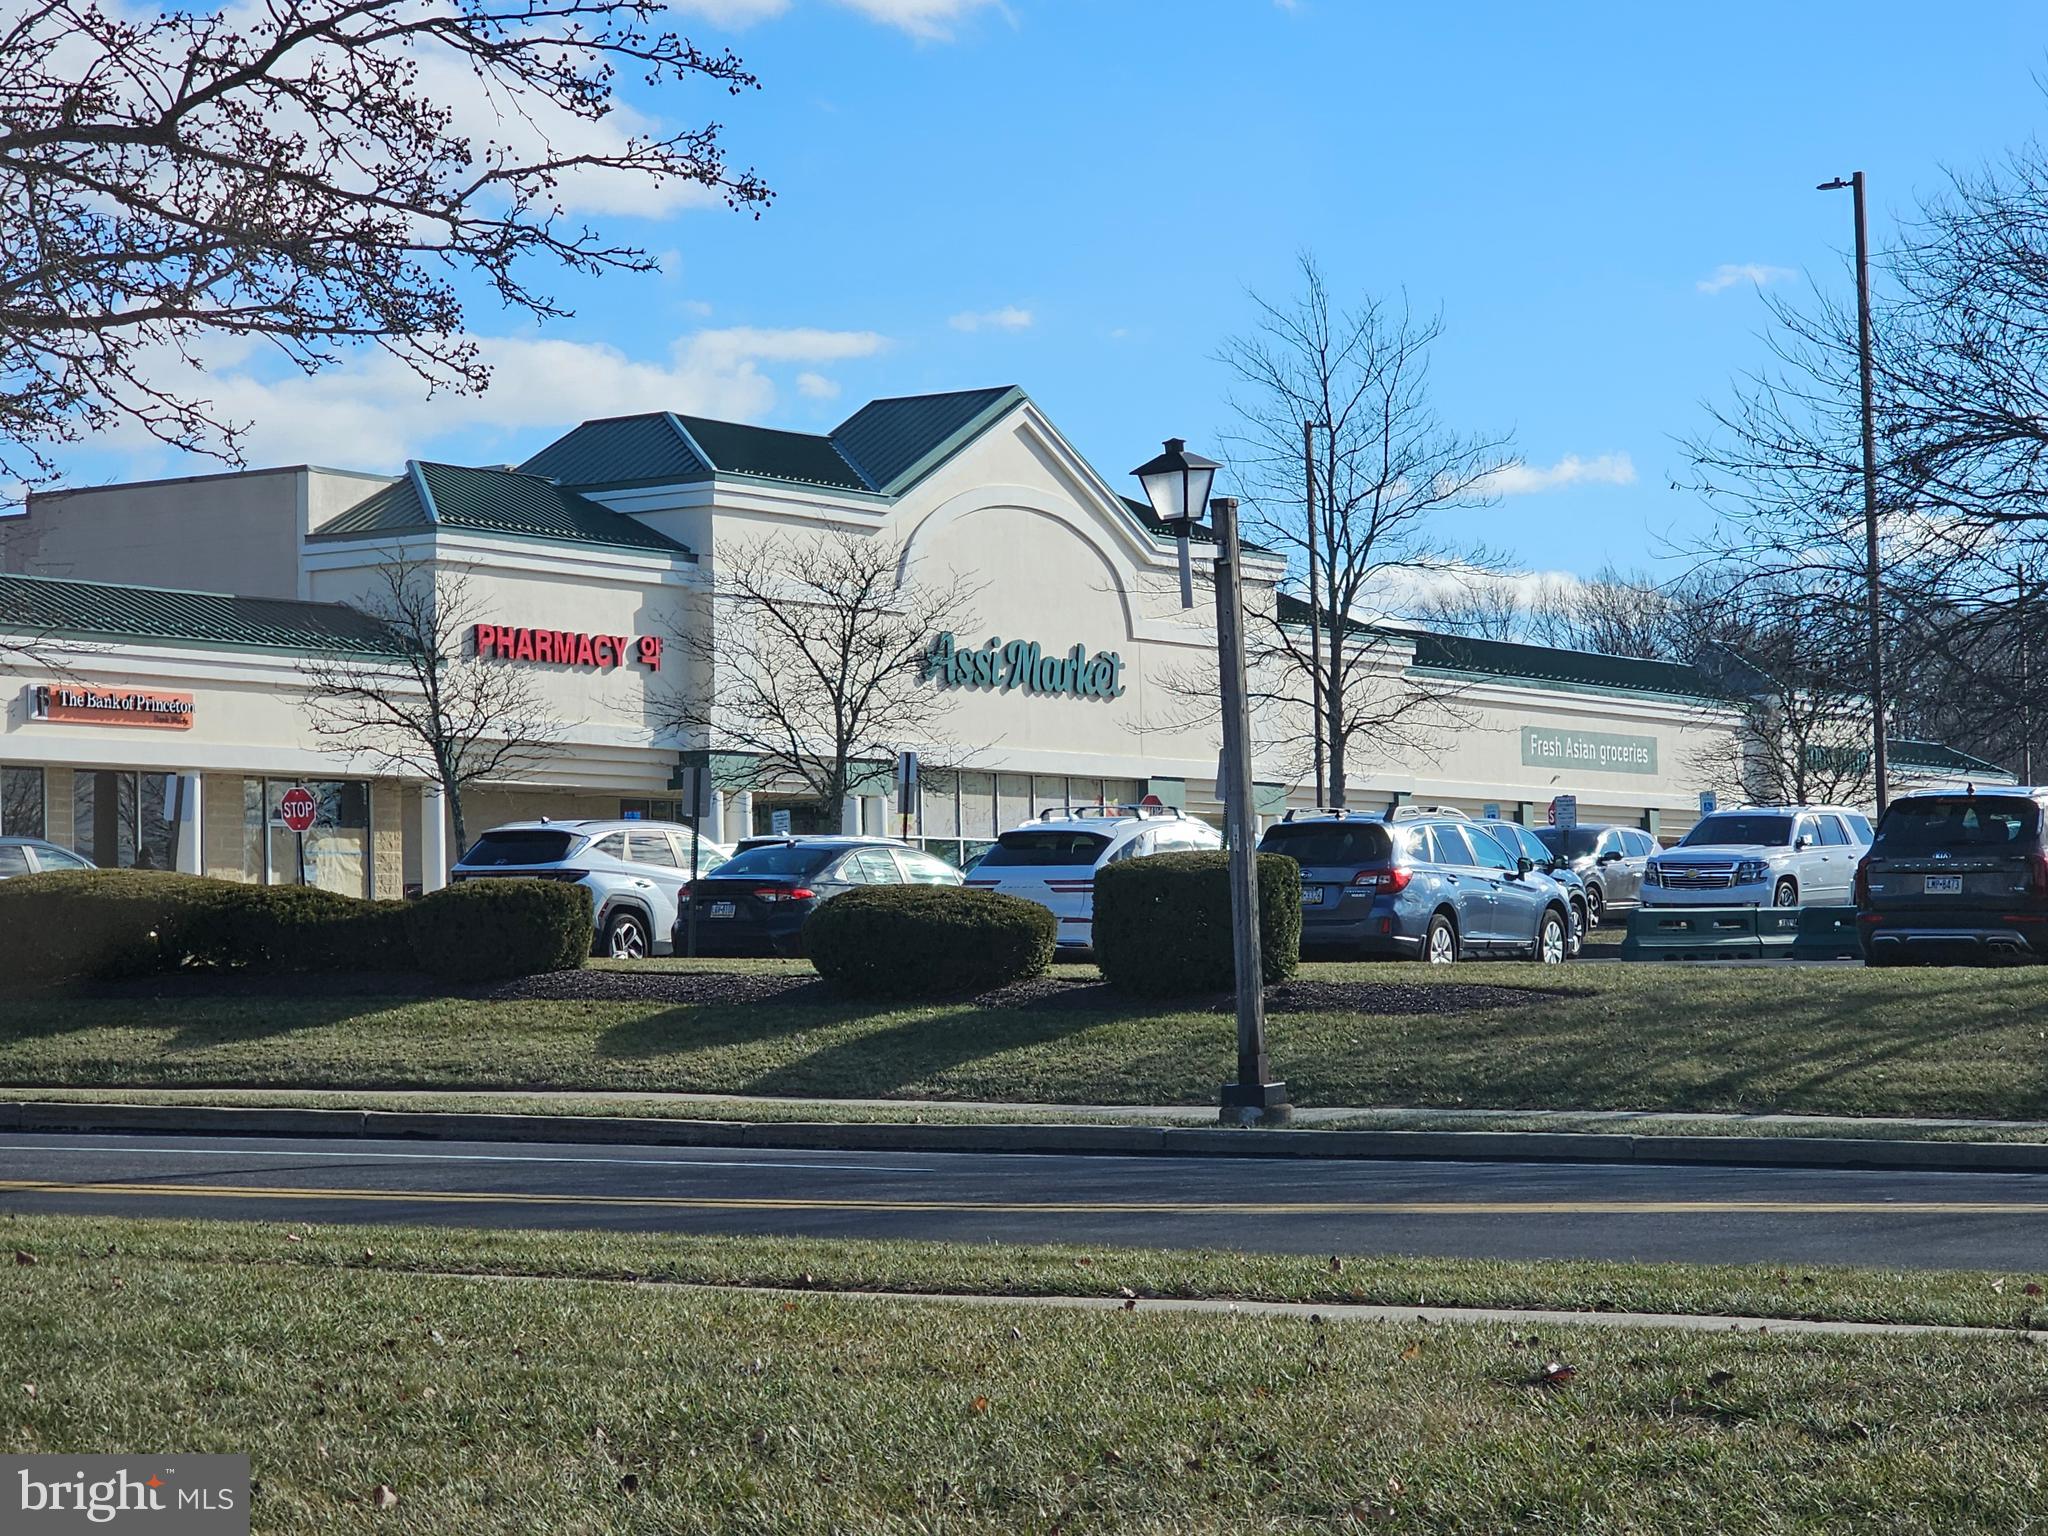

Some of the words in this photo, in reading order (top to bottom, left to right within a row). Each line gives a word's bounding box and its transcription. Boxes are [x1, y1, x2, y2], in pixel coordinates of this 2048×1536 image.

[477, 624, 627, 667] PHARMACY
[640, 635, 662, 672] 약
[923, 631, 1001, 683] Assi
[1007, 639, 1125, 697] Market
[60, 689, 85, 708] The
[87, 694, 121, 711] Bank
[122, 695, 134, 711] of
[137, 696, 196, 713] Princeton
[1530, 734, 1562, 757] Fresh
[1566, 737, 1596, 760] Asian
[1600, 743, 1648, 766] groceries
[284, 801, 313, 818] STOP
